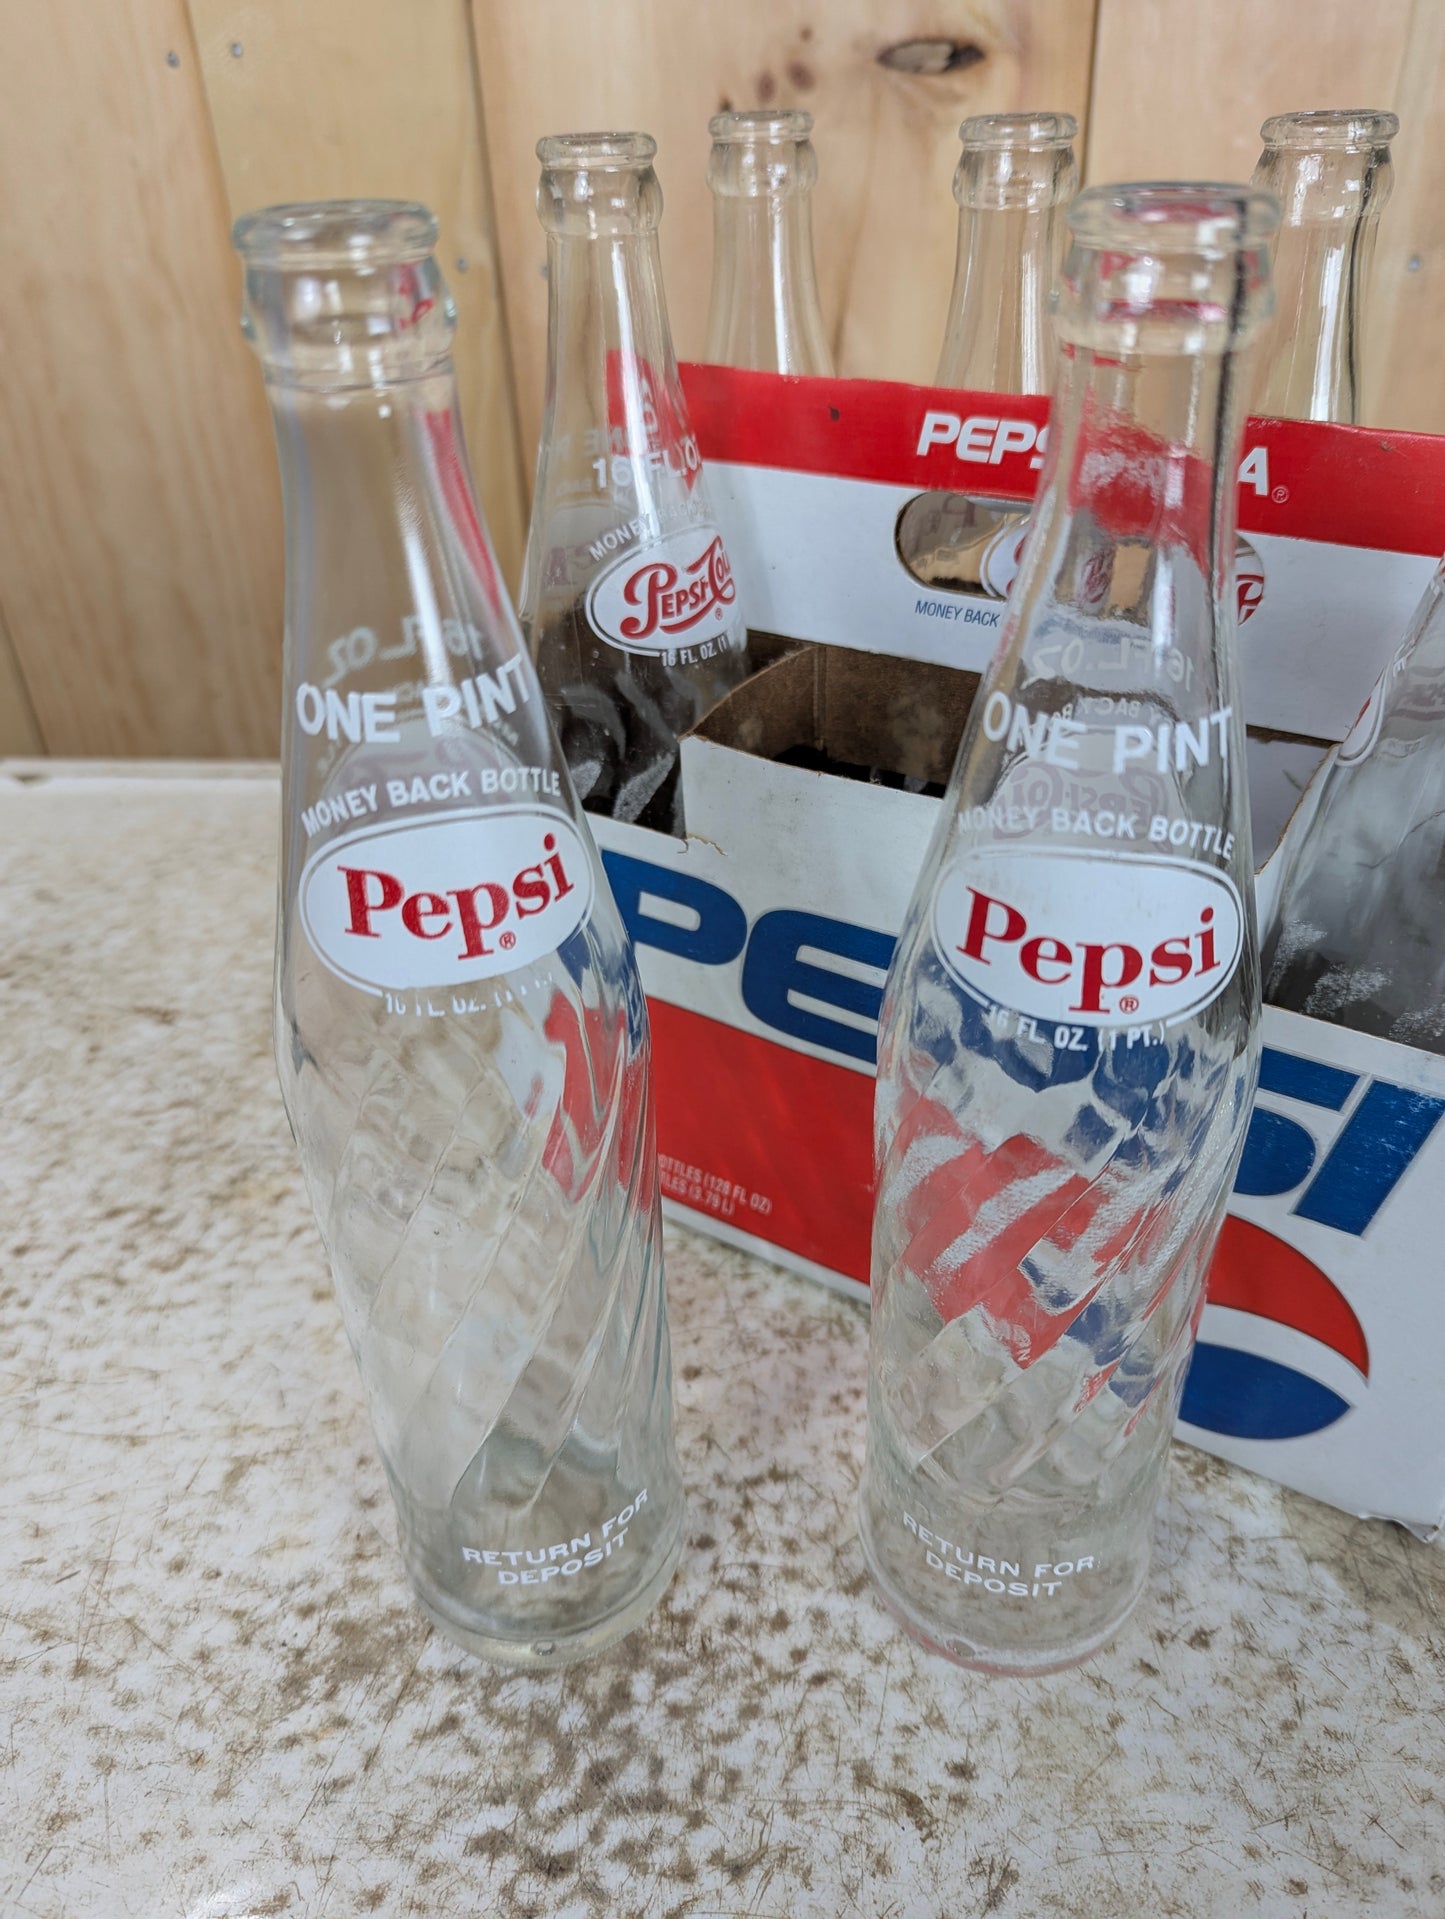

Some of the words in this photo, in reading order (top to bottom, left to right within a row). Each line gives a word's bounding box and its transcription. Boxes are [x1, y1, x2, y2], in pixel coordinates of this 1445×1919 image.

[592, 457, 634, 488] 16
[914, 600, 963, 621] MONEY
[964, 608, 1001, 628] BACK
[661, 651, 677, 667] 16
[680, 645, 698, 665] FL.
[297, 682, 401, 743] ONE
[423, 654, 531, 737] PINT
[983, 692, 1088, 769] ONE
[1112, 706, 1233, 774] PINT
[301, 784, 378, 838] MONEY
[387, 770, 471, 809] BACK
[481, 765, 562, 798] BOTTLE
[957, 805, 1039, 835] MONEY
[1052, 810, 1136, 840] BACK
[1149, 817, 1236, 861] BOTTLE
[337, 833, 575, 960] Pepsi
[956, 885, 1221, 1014] Pepsi
[989, 1005, 1010, 1029] 16
[1054, 1026, 1088, 1051] OZ.
[1127, 1019, 1165, 1050] PT.)
[658, 1153, 702, 1183] OTTLES
[462, 1532, 592, 1566] RETURN
[601, 1488, 648, 1538] FOR
[498, 1527, 629, 1585] DEPOSIT
[902, 1510, 1020, 1577] RETURN
[1034, 1555, 1095, 1578] FOR
[925, 1550, 1062, 1597] DEPOSIT
